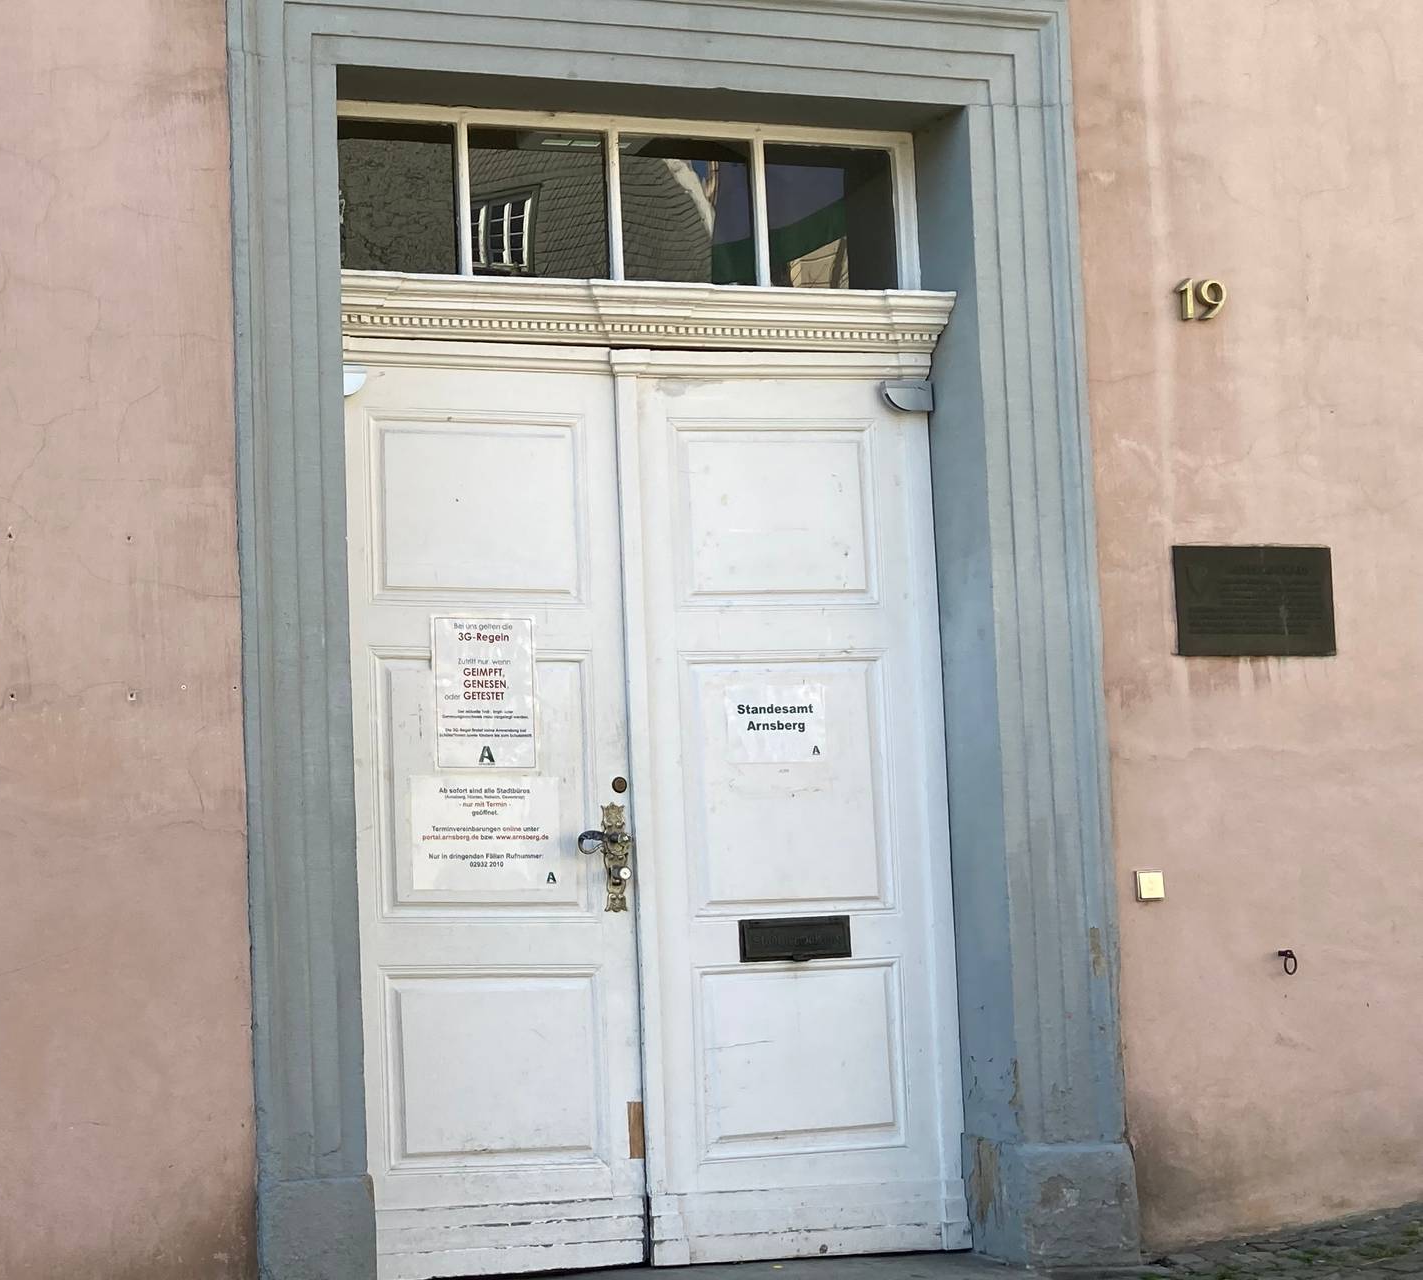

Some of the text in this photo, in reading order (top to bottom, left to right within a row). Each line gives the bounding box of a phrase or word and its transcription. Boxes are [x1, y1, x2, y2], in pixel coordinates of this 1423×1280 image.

[1175, 278, 1227, 321] 19
[458, 632, 510, 643] 3G-Regeln
[463, 668, 505, 678] GEIMPFT,
[463, 680, 509, 689] GENESEN,
[463, 692, 505, 700] GETESTET
[737, 704, 813, 715] Standesamt
[747, 720, 805, 732] Arnsberg
